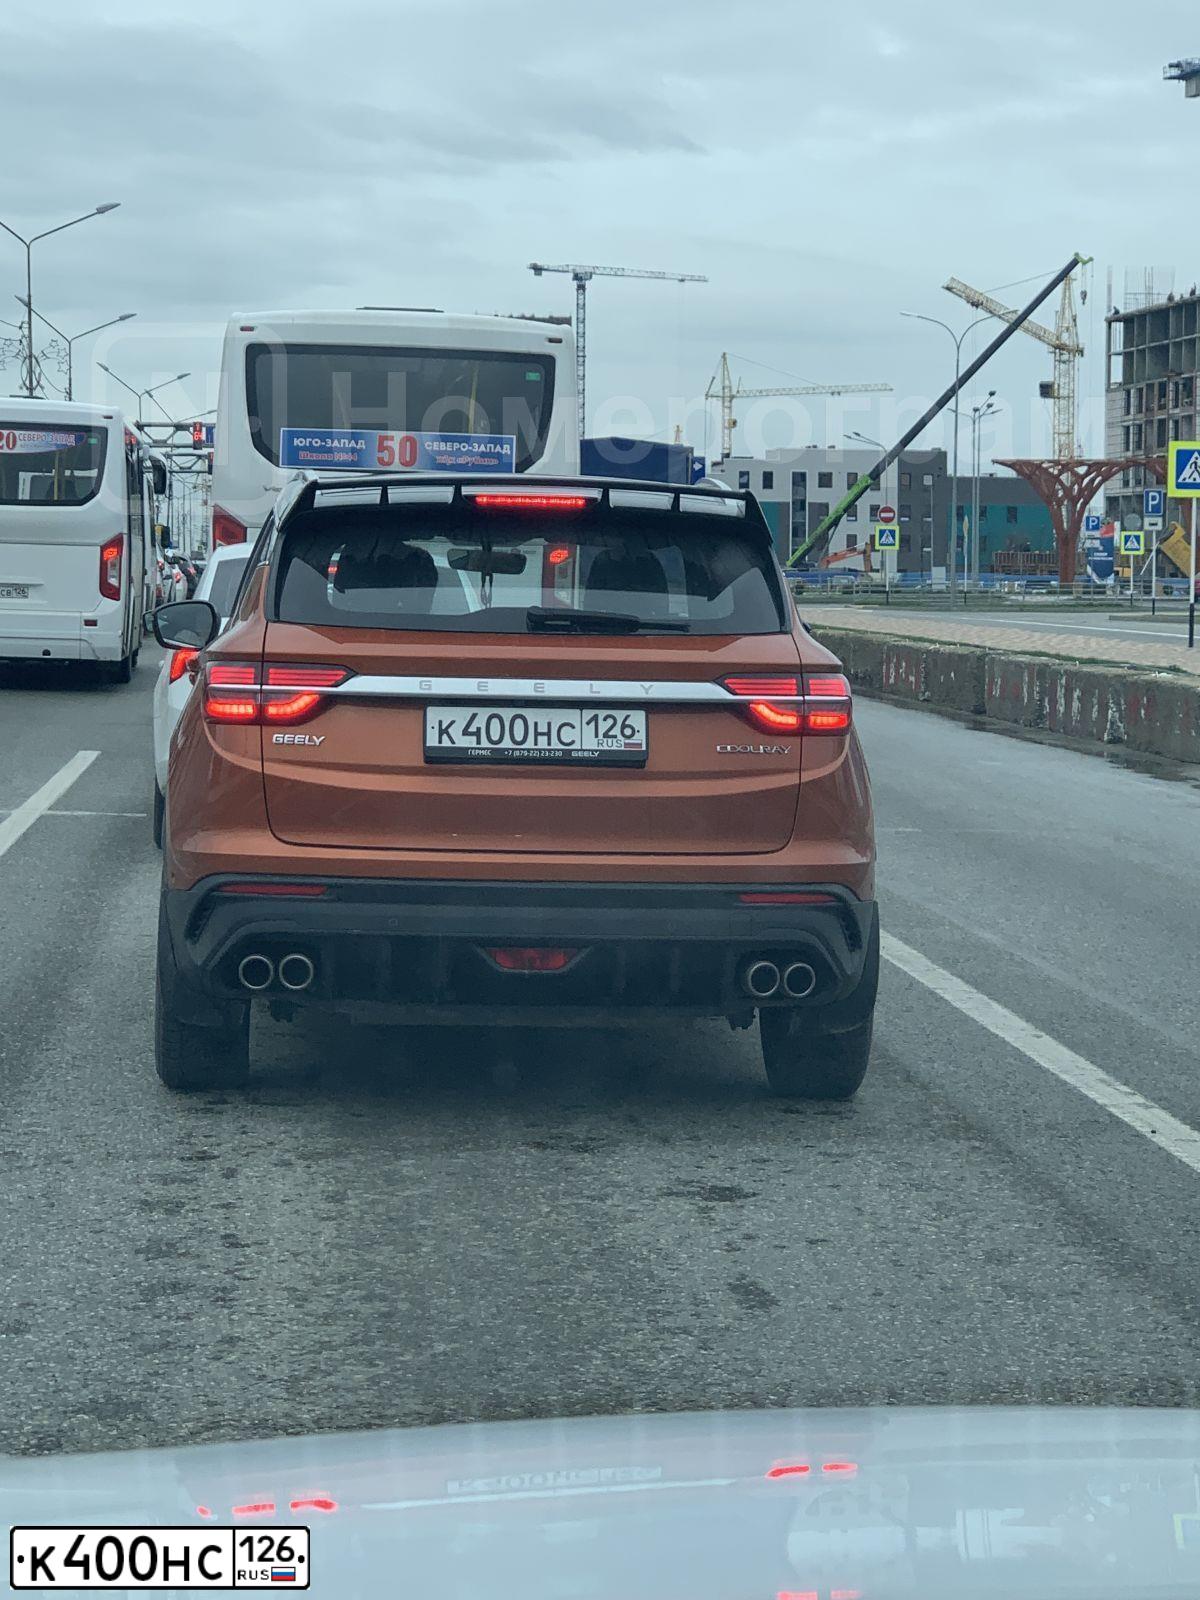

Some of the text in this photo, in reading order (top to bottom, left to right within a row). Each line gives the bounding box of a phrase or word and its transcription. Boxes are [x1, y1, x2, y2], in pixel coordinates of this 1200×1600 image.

[293, 434, 511, 468] ЮГО-ЗАПАД 50 СЕВЕРО-ЗАПАД
[1148, 492, 1160, 512] P
[1089, 517, 1098, 529] P
[418, 679, 655, 695] GEELY
[437, 712, 637, 747] К400НС 126
[272, 733, 326, 747] GEELY
[596, 738, 624, 749] RUS
[716, 744, 792, 754] COOLRAY
